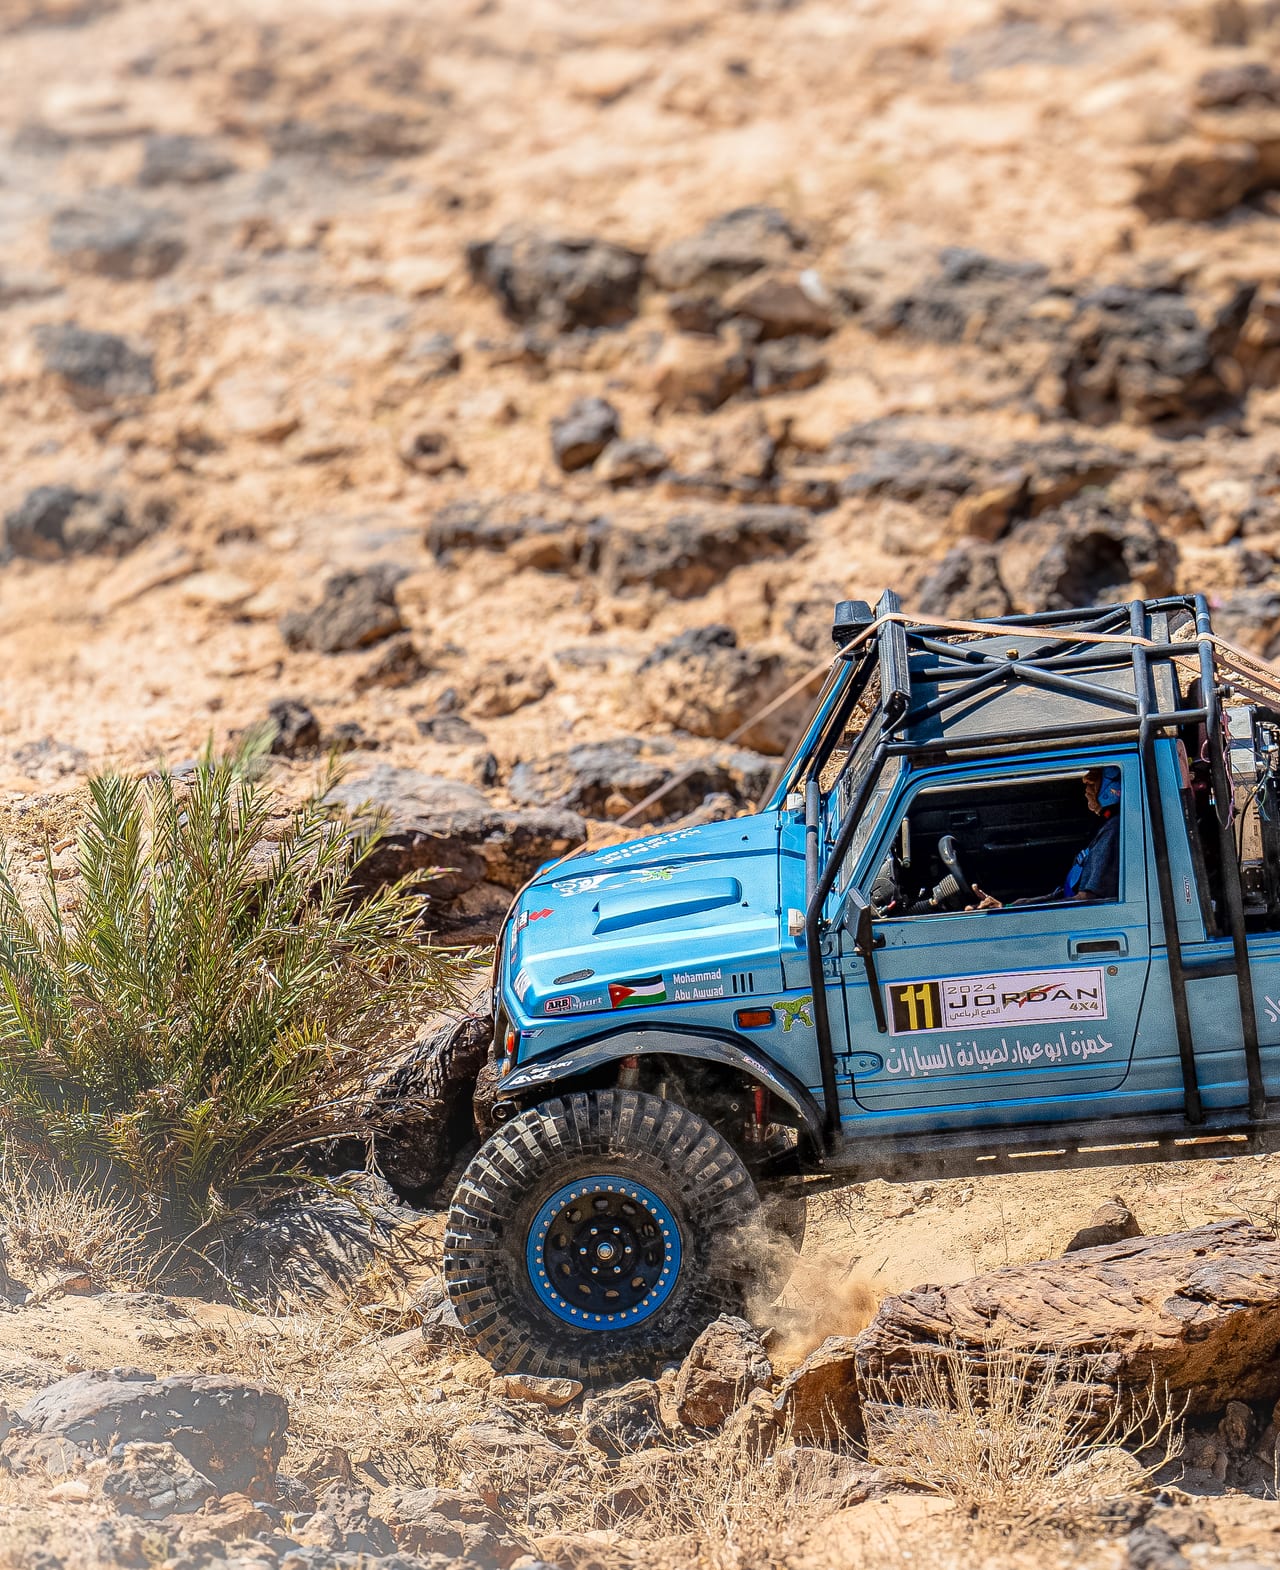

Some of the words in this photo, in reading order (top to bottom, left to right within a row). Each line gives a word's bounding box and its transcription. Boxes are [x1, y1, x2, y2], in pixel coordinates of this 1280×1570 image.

[673, 968, 722, 986] Mohammad
[674, 988, 692, 1001] Abu
[947, 983, 997, 995] 2024
[949, 987, 1098, 1009] JORDAN
[547, 999, 569, 1010] ARB
[900, 983, 935, 1030] 11
[950, 1009, 980, 1021] الرباعي
[957, 1038, 1010, 1072] لصيانة
[1070, 1030, 1113, 1060] حمزة
[886, 1044, 954, 1077] السيارات
